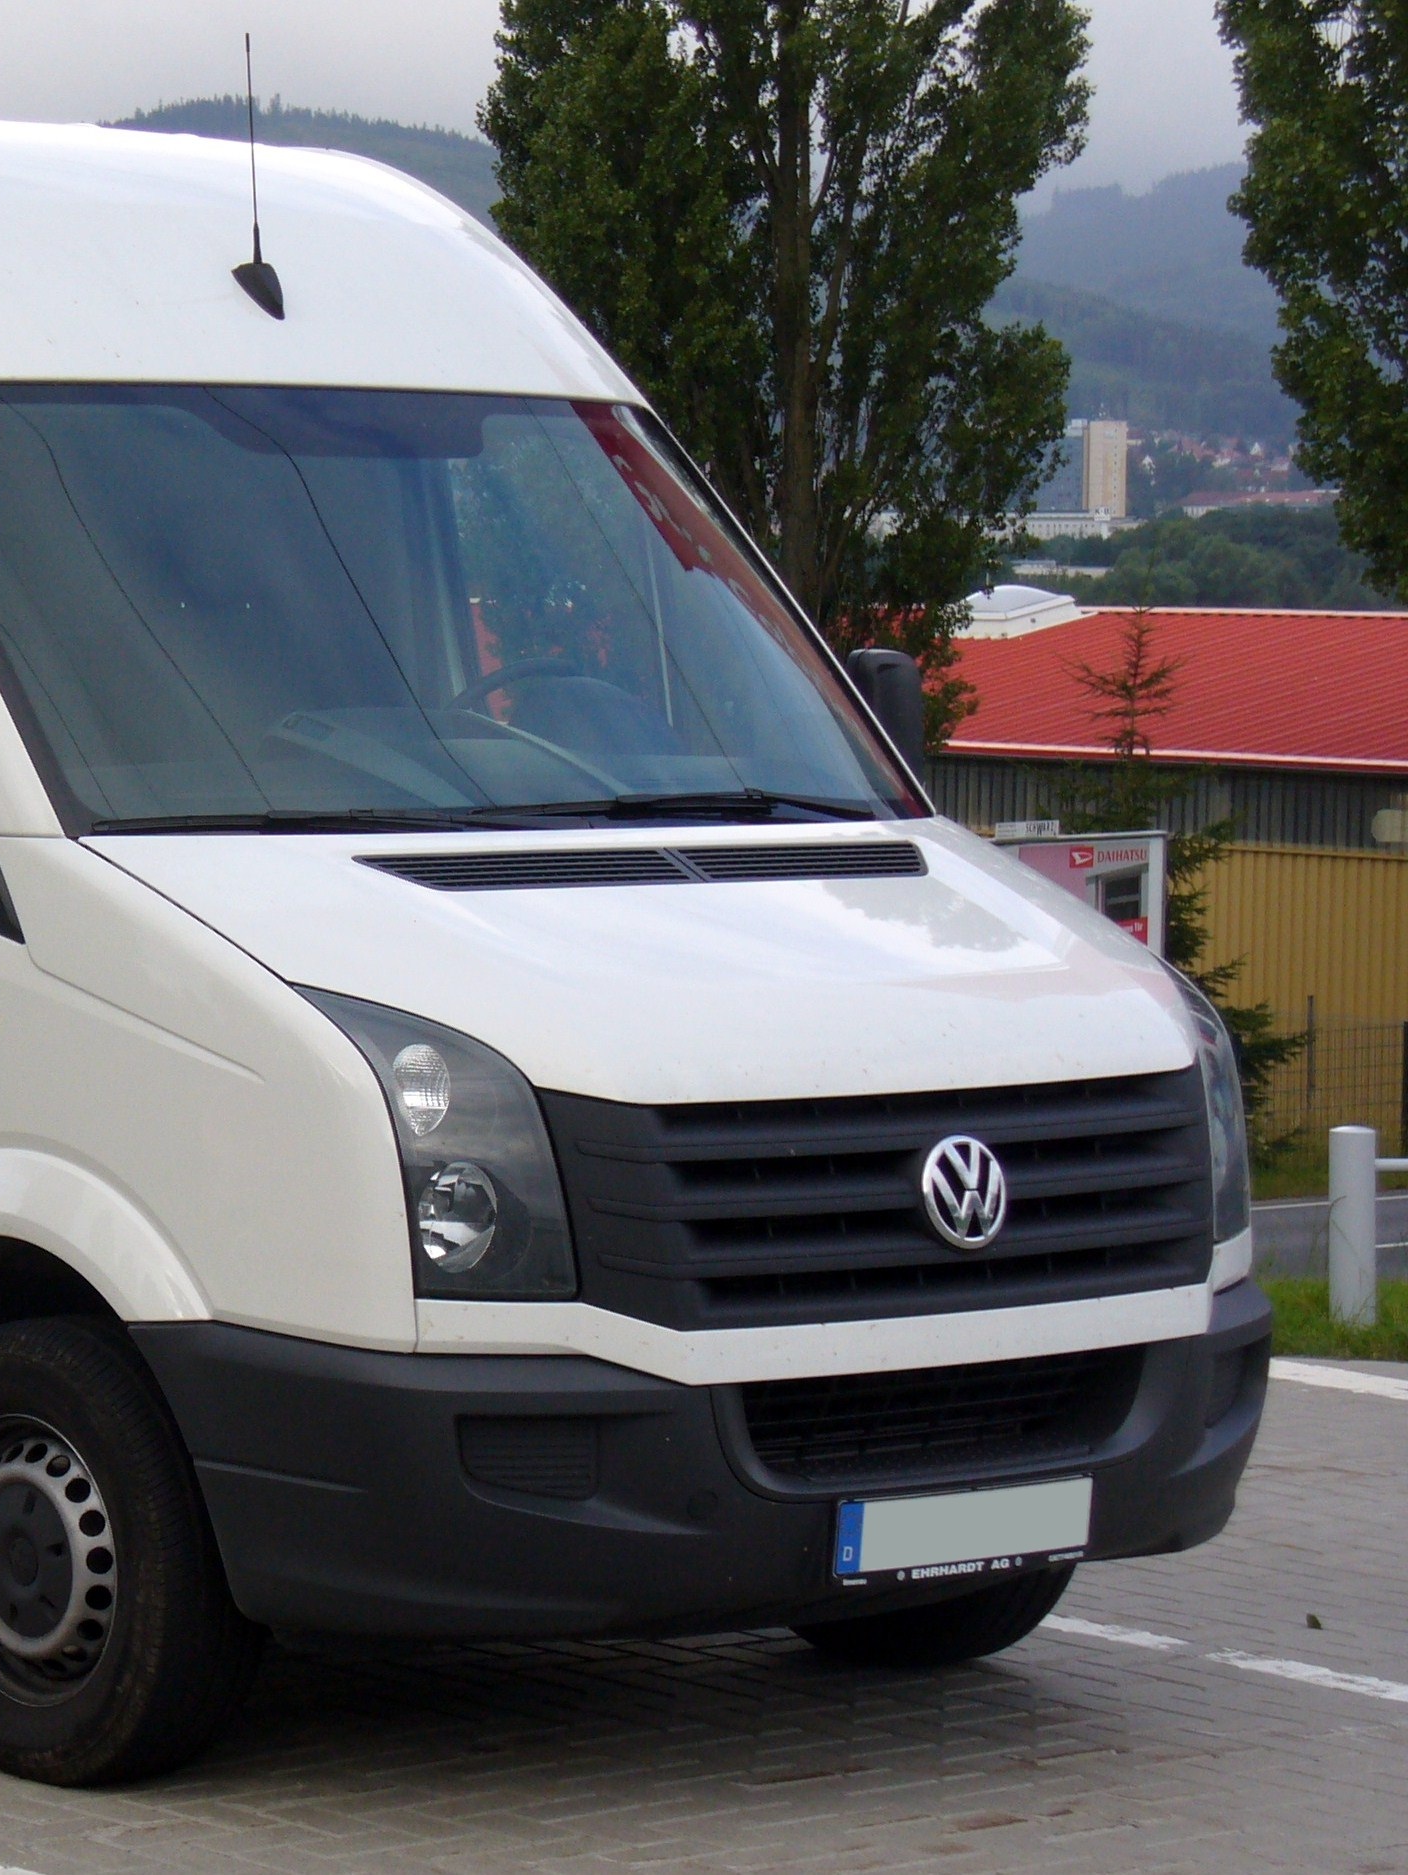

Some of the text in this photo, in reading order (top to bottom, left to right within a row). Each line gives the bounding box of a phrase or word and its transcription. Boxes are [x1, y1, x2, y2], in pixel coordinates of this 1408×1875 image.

[1097, 849, 1147, 863] DAIHATSU
[843, 1546, 853, 1562] D
[911, 1557, 1010, 1580] EHRHARDT AG
